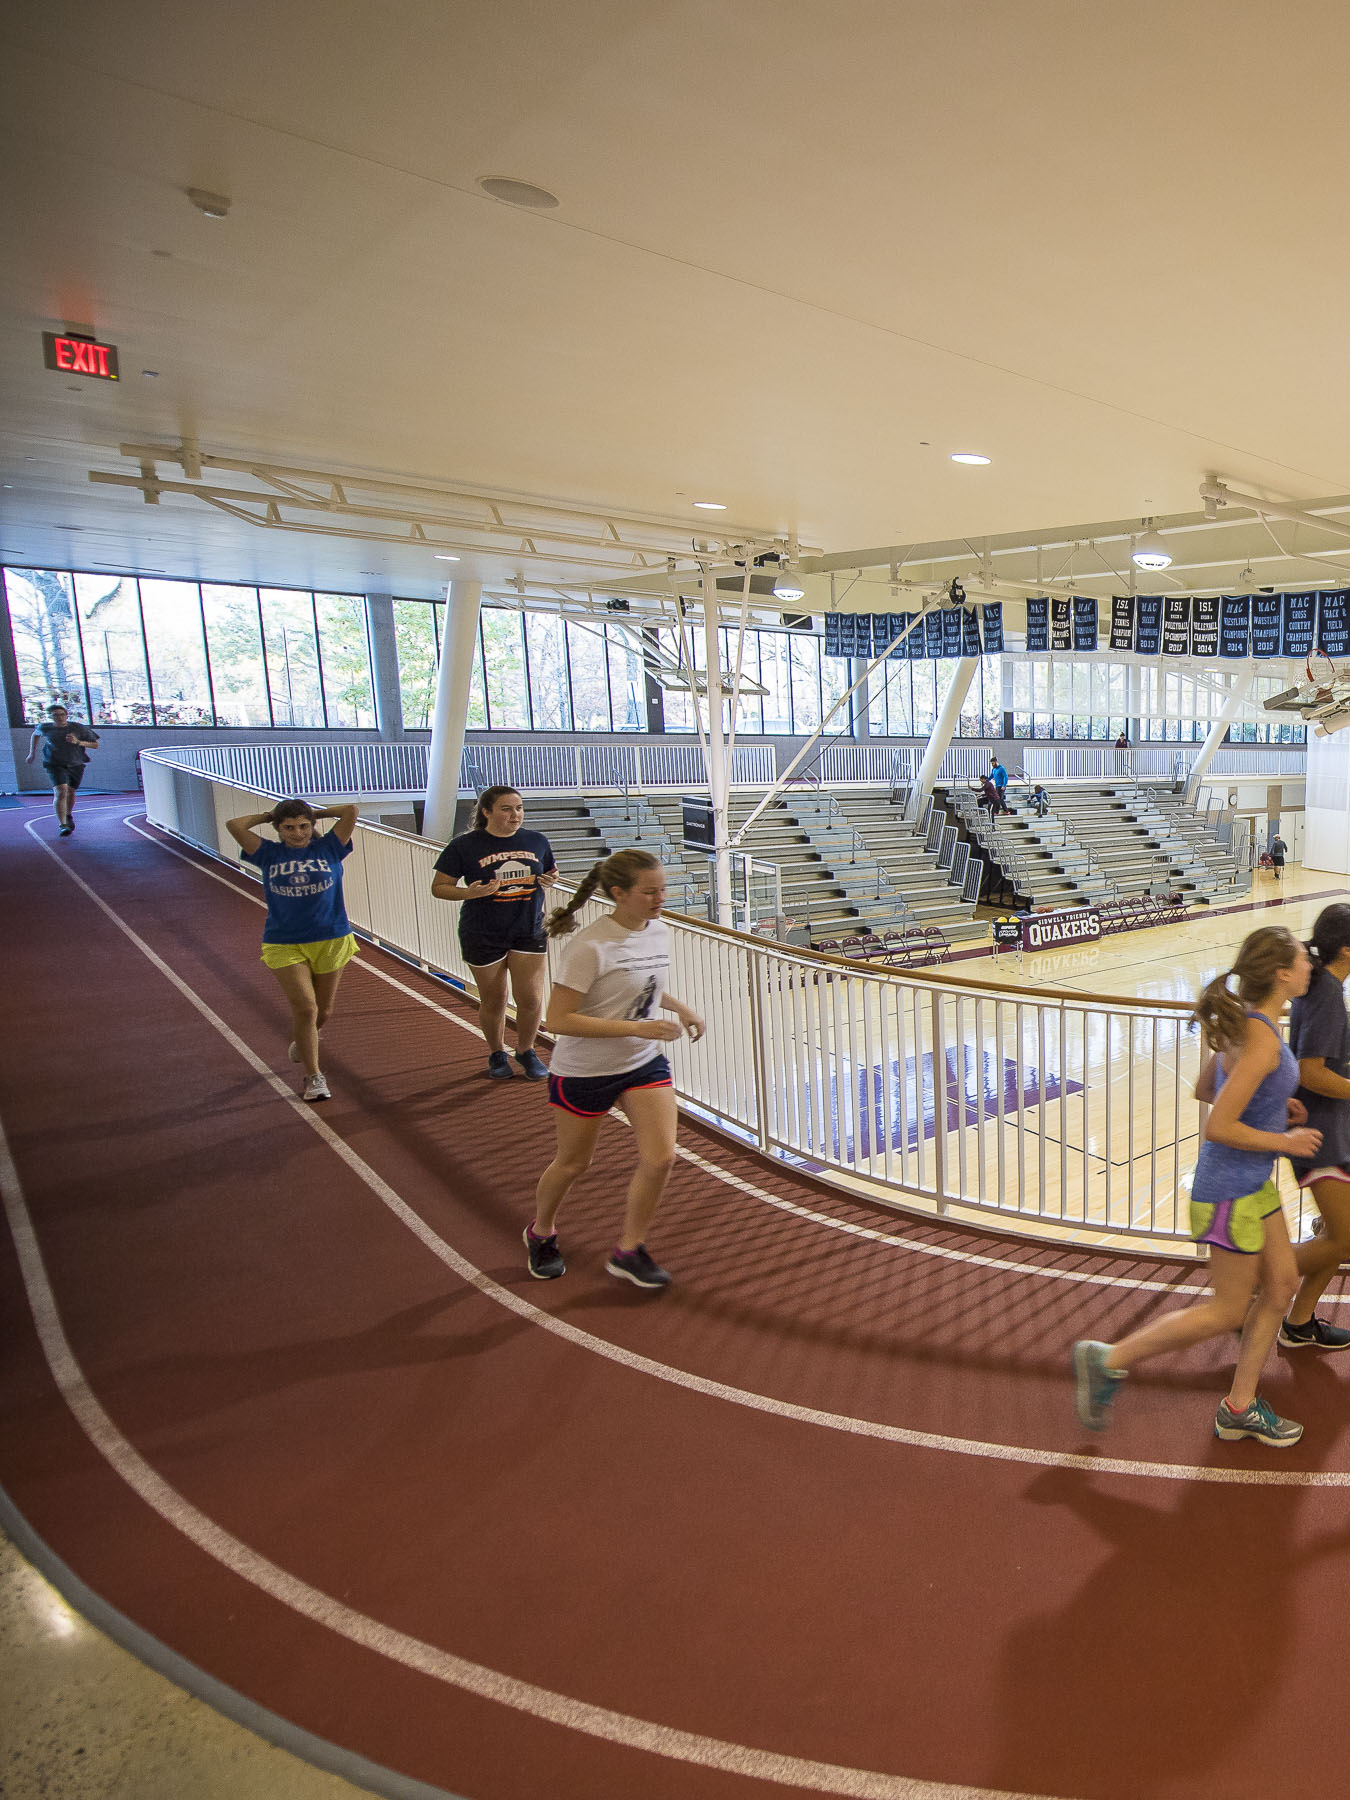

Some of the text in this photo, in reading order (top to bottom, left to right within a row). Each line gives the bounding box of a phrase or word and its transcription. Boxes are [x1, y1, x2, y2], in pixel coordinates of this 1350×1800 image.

[54, 337, 110, 376] EXIT
[1116, 600, 1129, 609] ISL
[1290, 597, 1310, 608] MAC
[1324, 595, 1345, 607] MAC
[1030, 604, 1044, 613] MAC
[1141, 603, 1158, 612] MAC
[1170, 602, 1184, 611] ISL
[1199, 602, 1214, 611] ISL
[1227, 603, 1243, 614] MAC
[1258, 601, 1277, 612] MAC
[1292, 610, 1307, 619] CROSS
[1288, 620, 1311, 631] COUNTRY
[1286, 632, 1313, 642] CHAMPIONS
[1322, 630, 1349, 641] CHAMPIONS
[1115, 639, 1128, 647] 2012
[1140, 640, 1155, 648] 2013
[1226, 643, 1243, 652] 2014
[1257, 642, 1274, 651] 2015
[1327, 643, 1344, 652] 2016
[1197, 645, 1213, 653] 2014
[1290, 643, 1308, 653] 2015
[269, 859, 332, 879] DUKE
[1038, 912, 1090, 925] SIDWELL FRIENDS
[1029, 915, 1100, 946] QUAKERS
